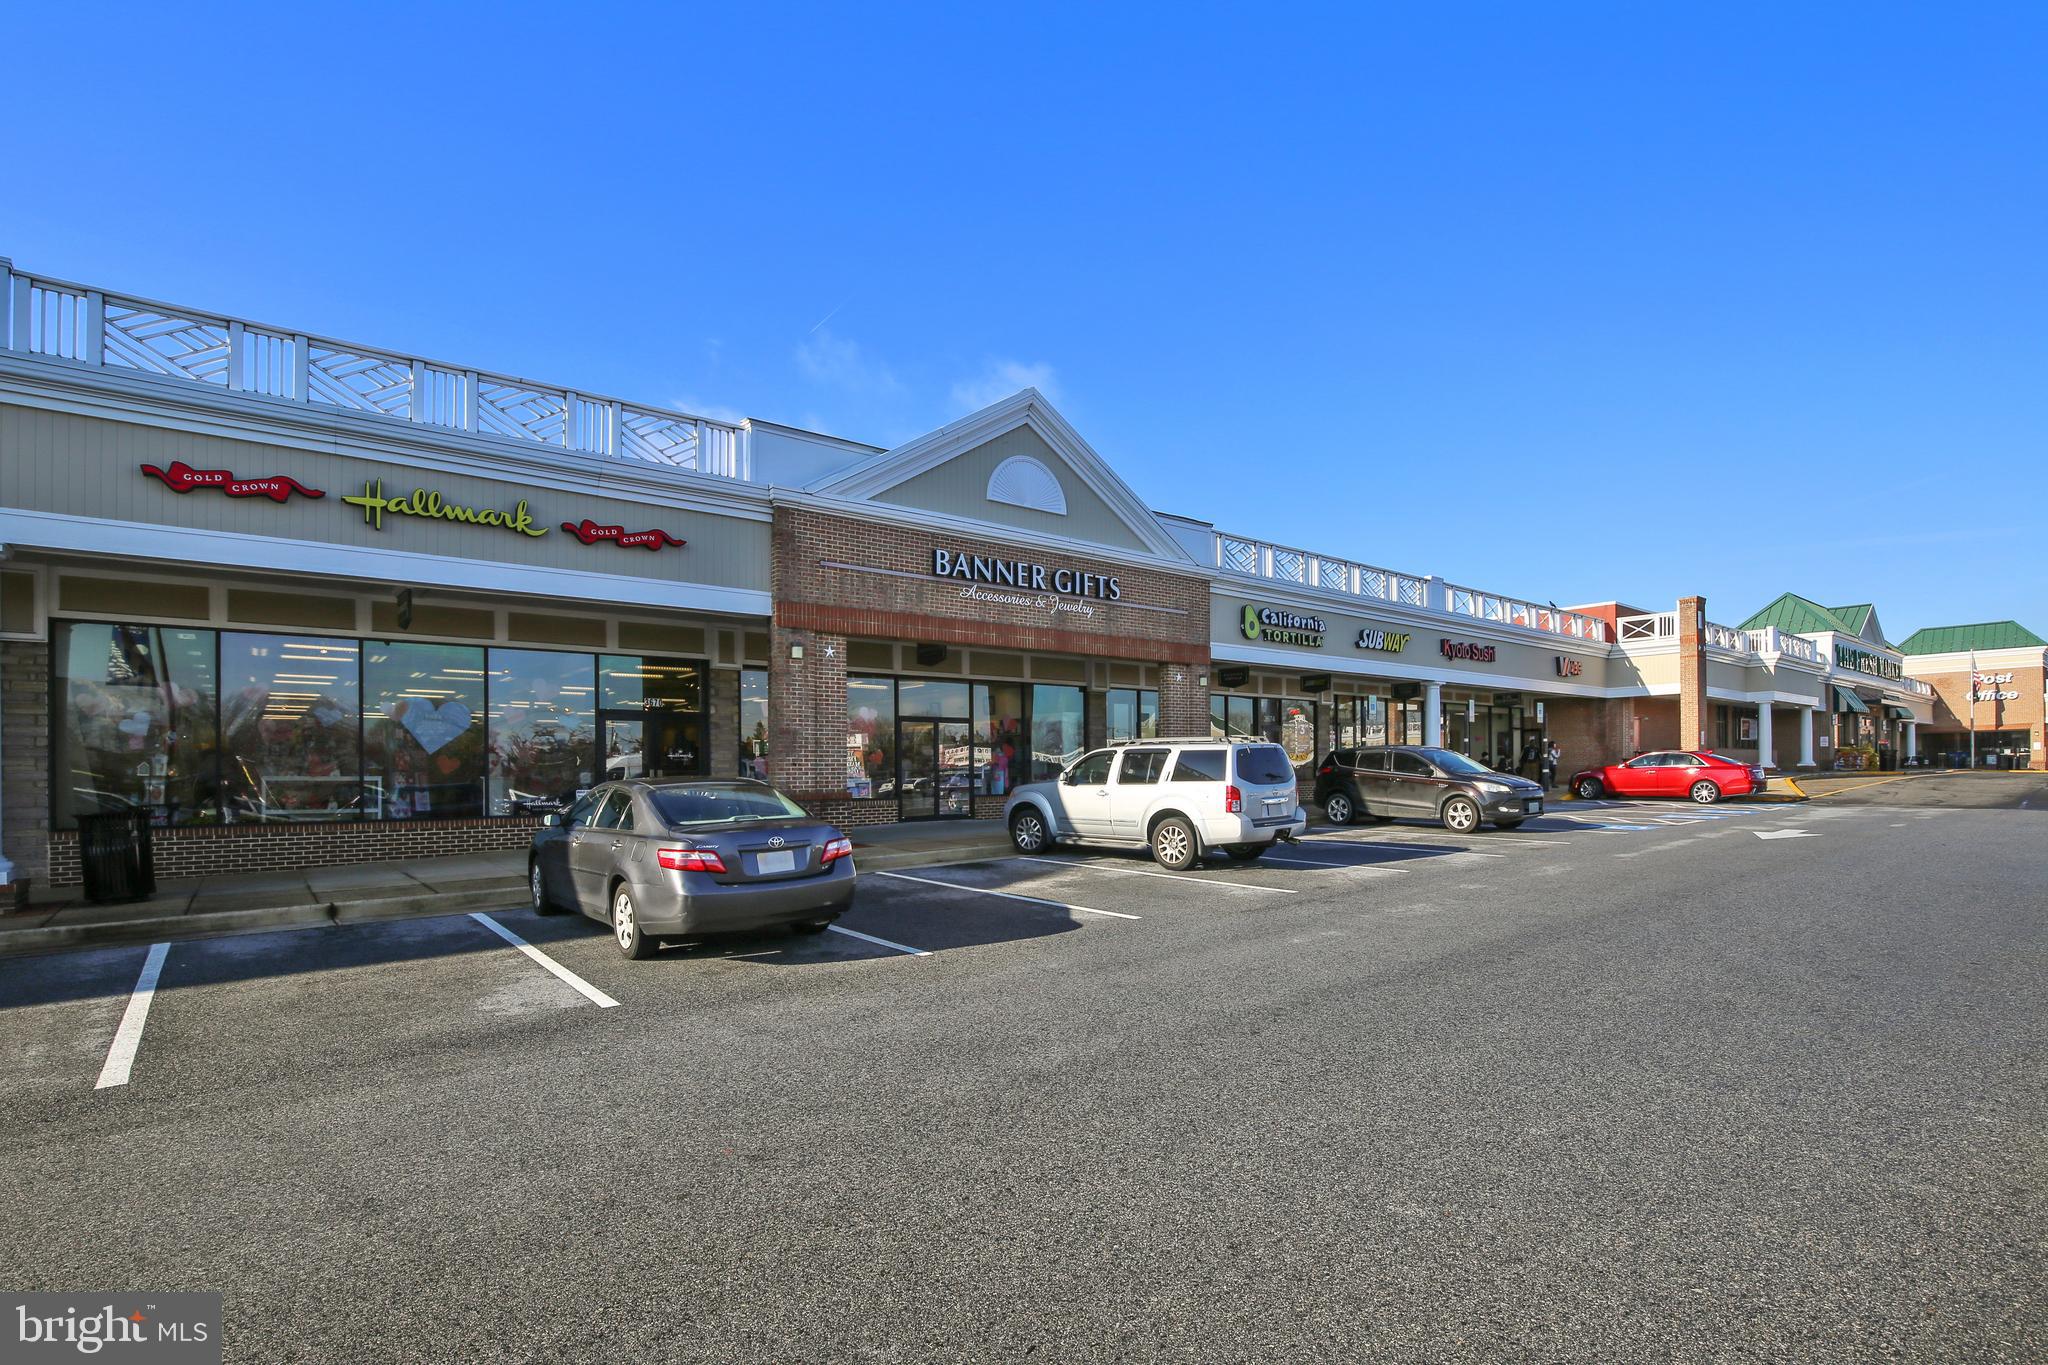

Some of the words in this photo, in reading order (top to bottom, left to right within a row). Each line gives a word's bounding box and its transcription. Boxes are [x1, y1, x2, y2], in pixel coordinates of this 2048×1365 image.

[183, 473, 222, 482] GOLD
[231, 482, 279, 492] CROWN
[340, 477, 550, 537] Hallmark
[590, 528, 618, 536] GOLD
[623, 535, 655, 543] CROWN
[935, 549, 1047, 591] BANNER
[1053, 568, 1122, 600] GIFTS
[959, 584, 1033, 608] Accessories
[1035, 595, 1047, 608] &
[1049, 594, 1095, 618] Jewelry
[1261, 607, 1326, 632] California
[1265, 629, 1323, 647] TORTILLA
[1359, 628, 1412, 653] SUBWAY
[1442, 638, 1470, 661] Kyoto
[1472, 643, 1496, 662] Sushi
[1836, 644, 1856, 669] THE
[1856, 651, 1878, 676] FRESH
[1879, 656, 1902, 682] MARKET
